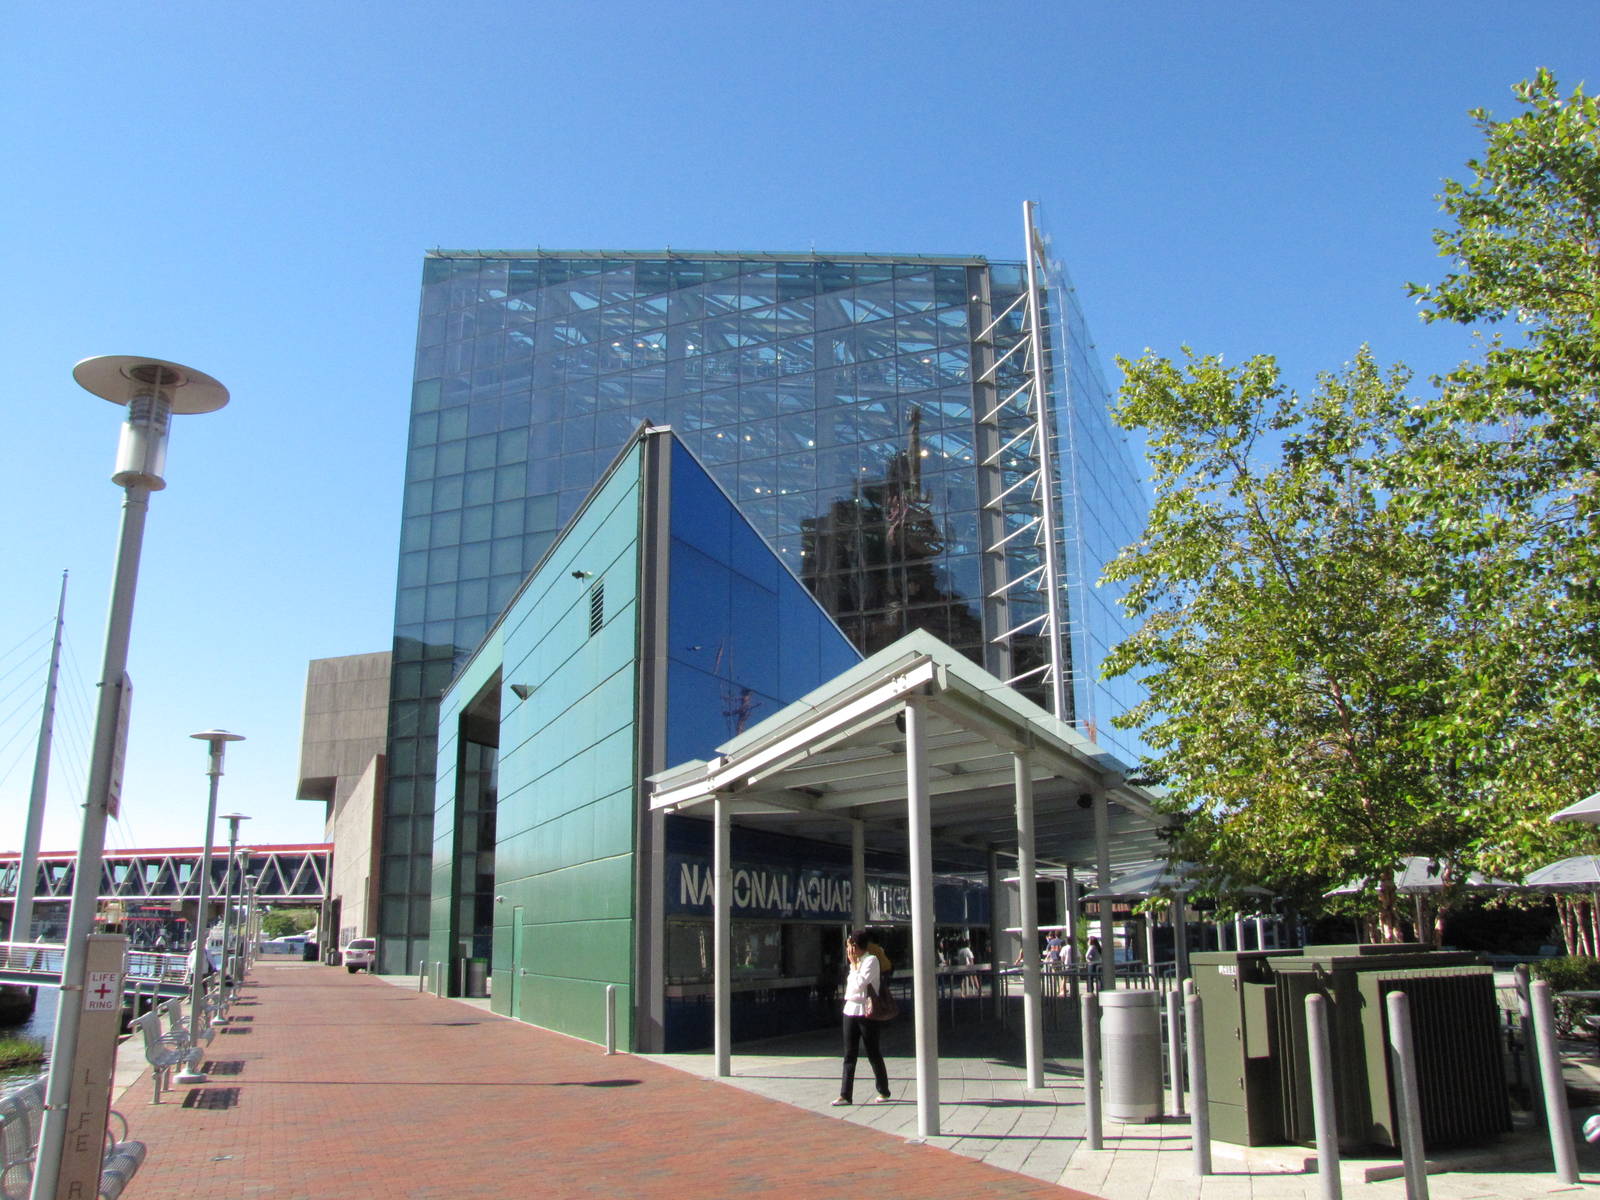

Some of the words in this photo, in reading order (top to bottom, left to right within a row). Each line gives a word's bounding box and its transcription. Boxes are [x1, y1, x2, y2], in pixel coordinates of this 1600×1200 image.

[681, 863, 791, 910] NAIONAL
[92, 973, 115, 981] LIFE
[89, 1001, 112, 1009] RING
